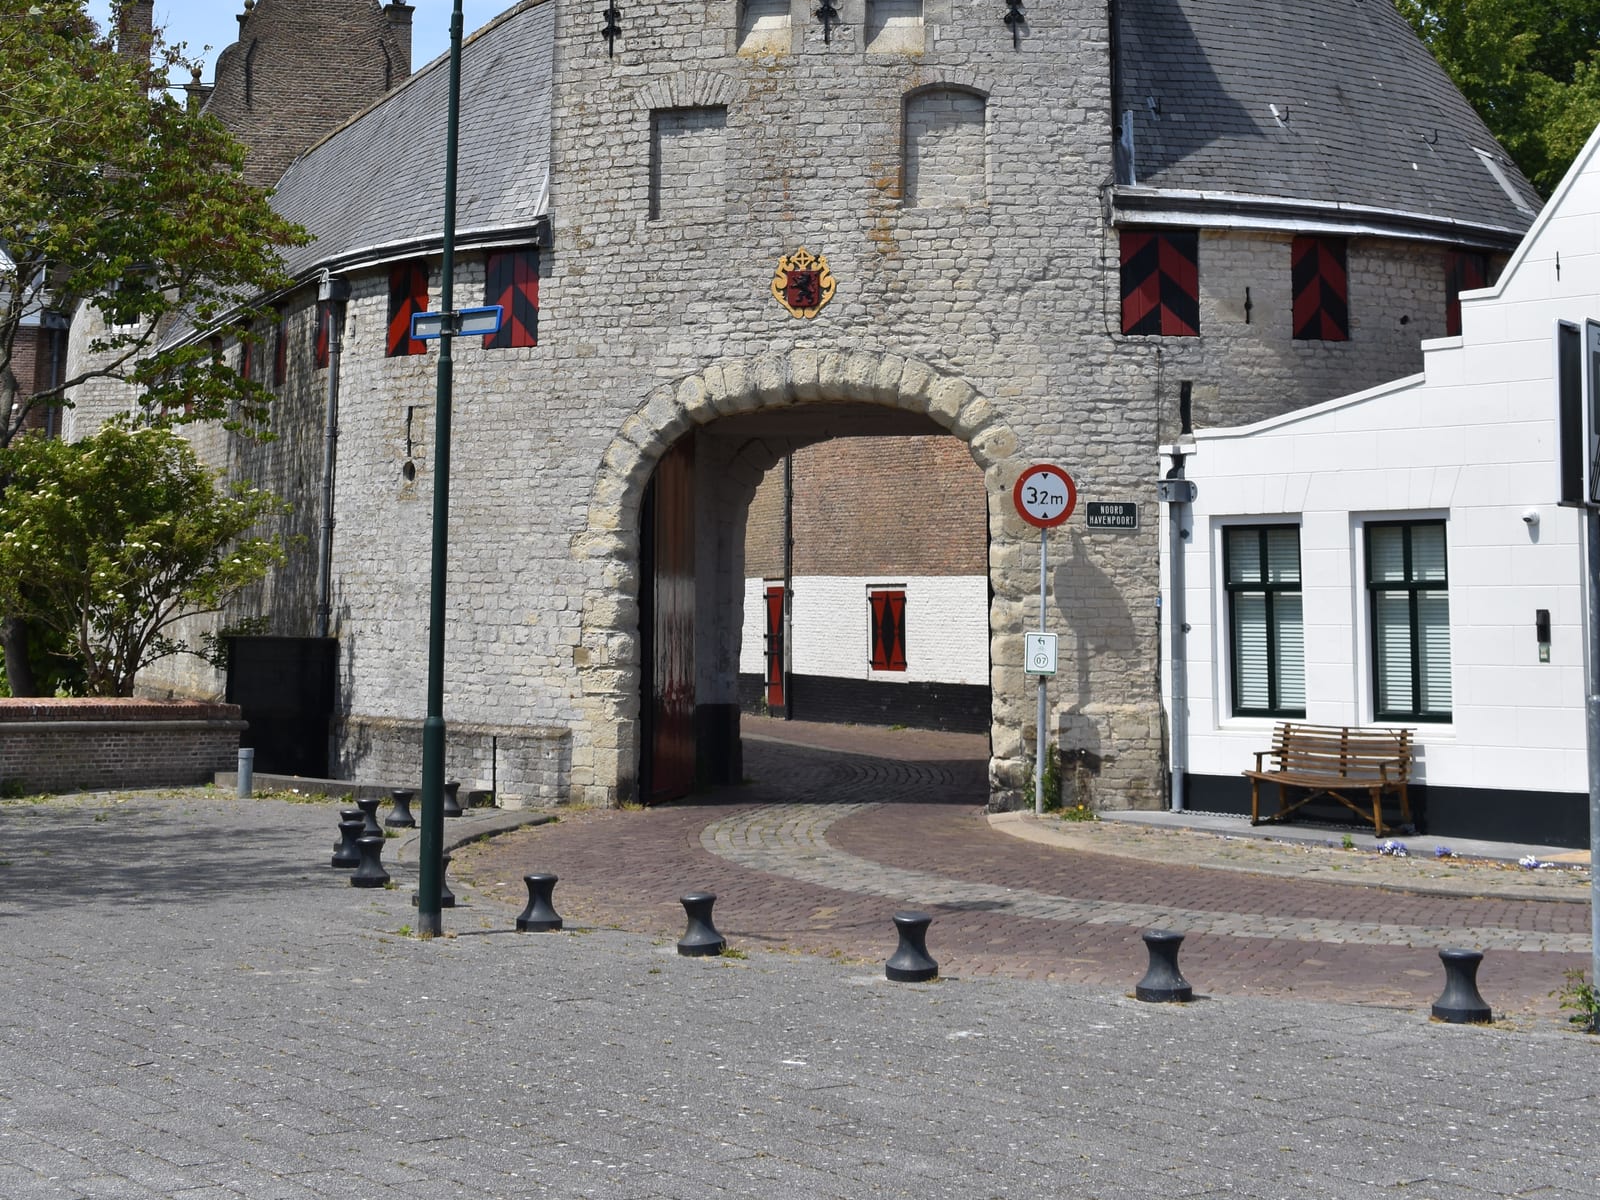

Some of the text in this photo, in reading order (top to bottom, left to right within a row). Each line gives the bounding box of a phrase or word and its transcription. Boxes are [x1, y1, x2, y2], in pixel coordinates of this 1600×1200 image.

[1100, 505, 1124, 515] NOORD
[1089, 515, 1134, 525] HAVENPOORT
[1036, 656, 1047, 665] 07
